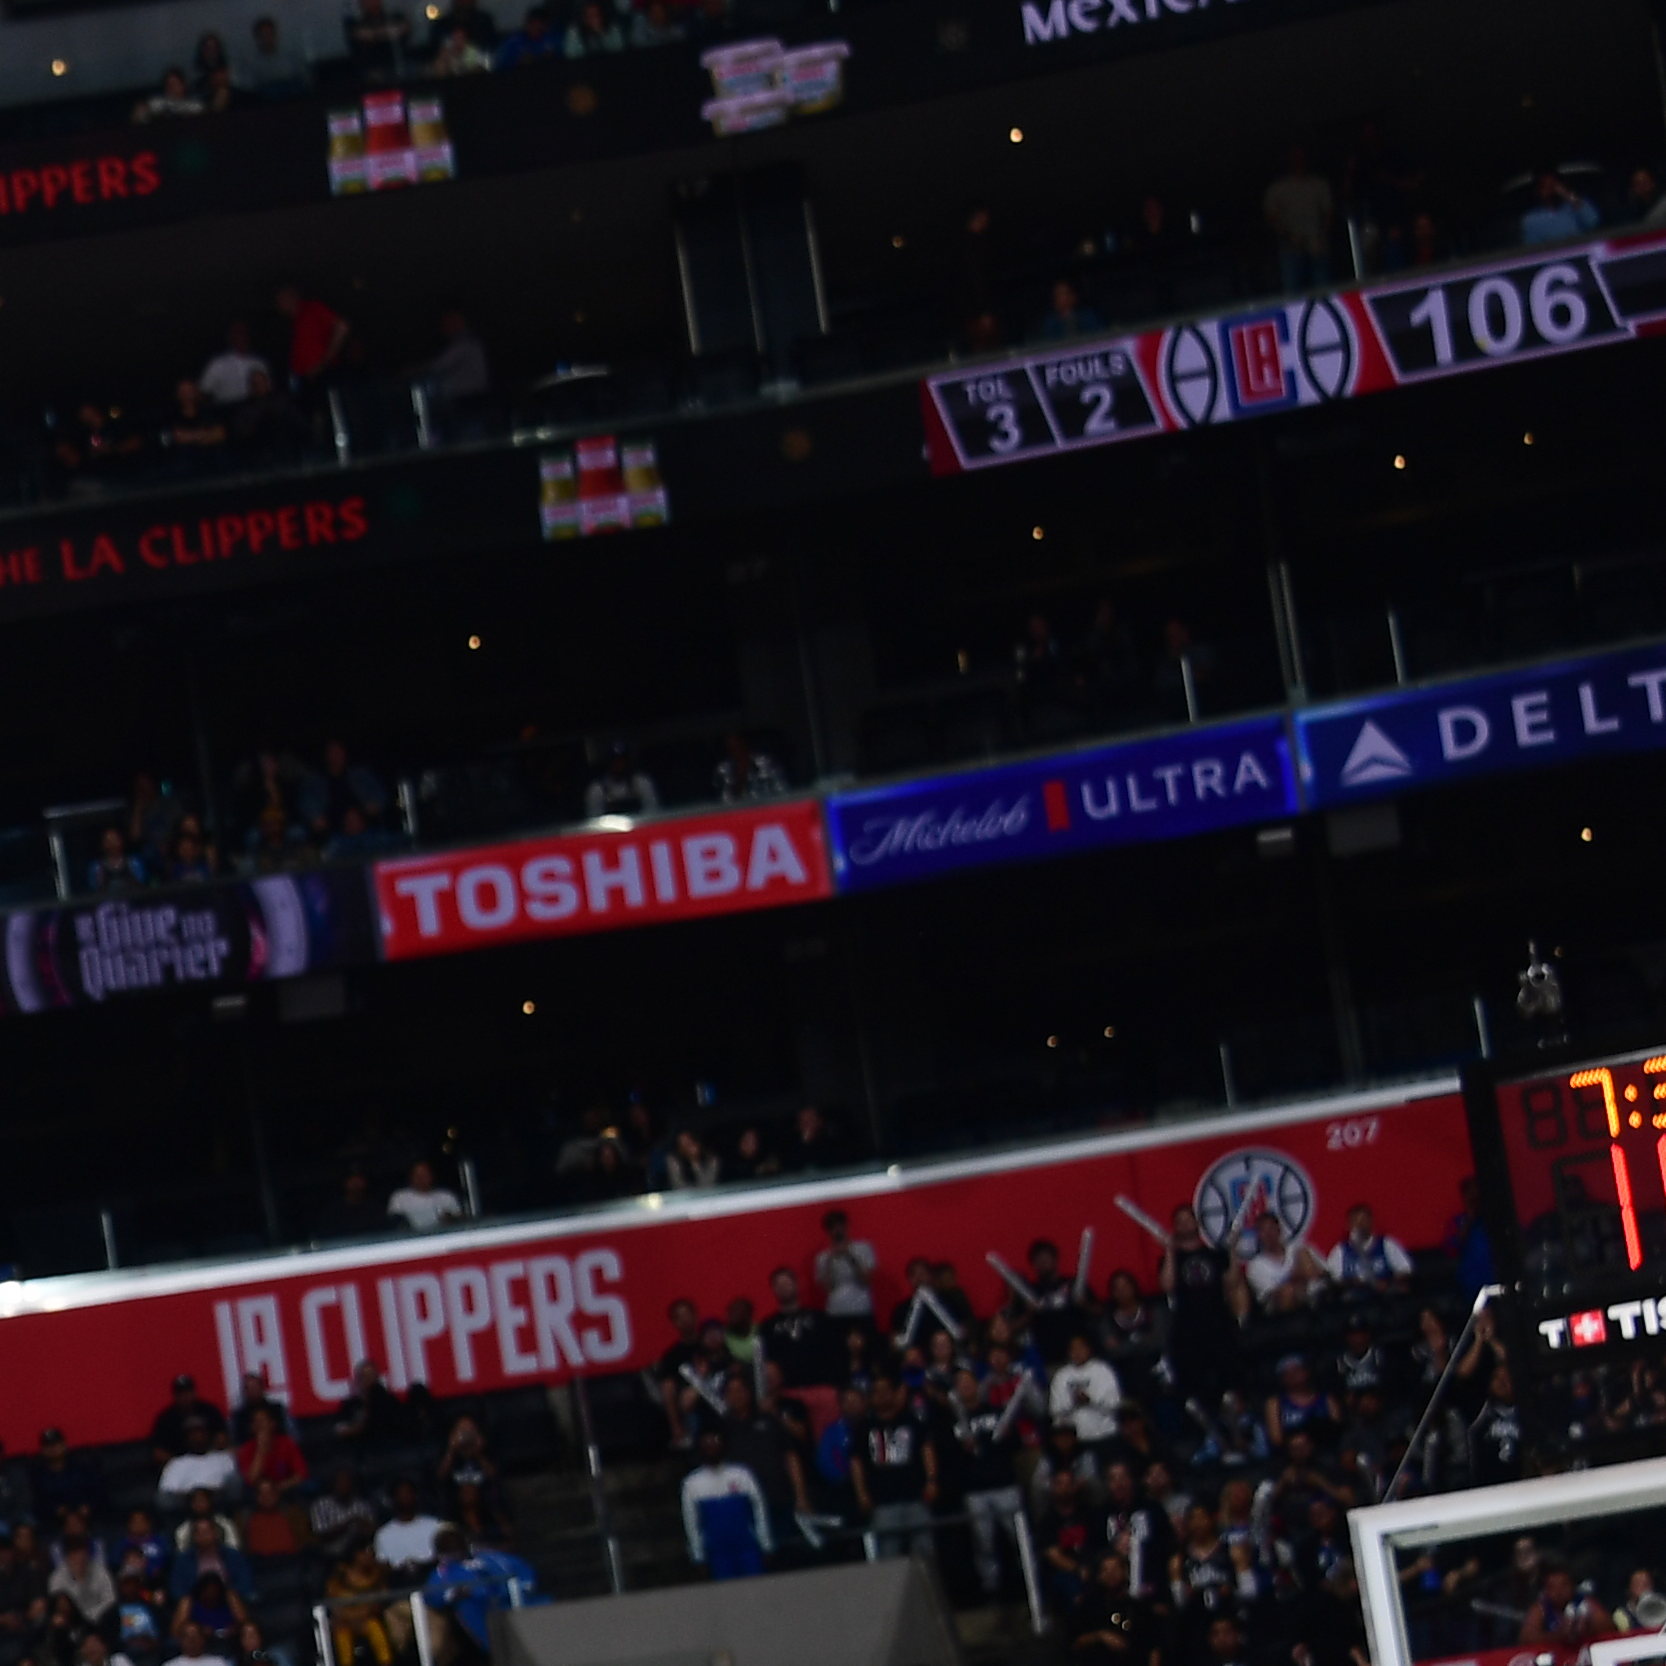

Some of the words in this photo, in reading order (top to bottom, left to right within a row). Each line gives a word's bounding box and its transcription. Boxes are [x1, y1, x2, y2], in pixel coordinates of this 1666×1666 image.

[1409, 264, 1590, 368] 106
[1044, 351, 1125, 389] FOULS
[985, 403, 1022, 455] 3
[1080, 384, 1116, 437] 2
[57, 532, 126, 581] LA
[137, 494, 371, 571] CLIPPERS
[849, 793, 1030, 868] Michelob
[1079, 751, 1272, 822] ULTRA
[396, 822, 808, 939] TOSHIBA
[1325, 1117, 1379, 1152] 207
[214, 1293, 293, 1412] LA
[300, 1247, 633, 1402] CLIPPERS
